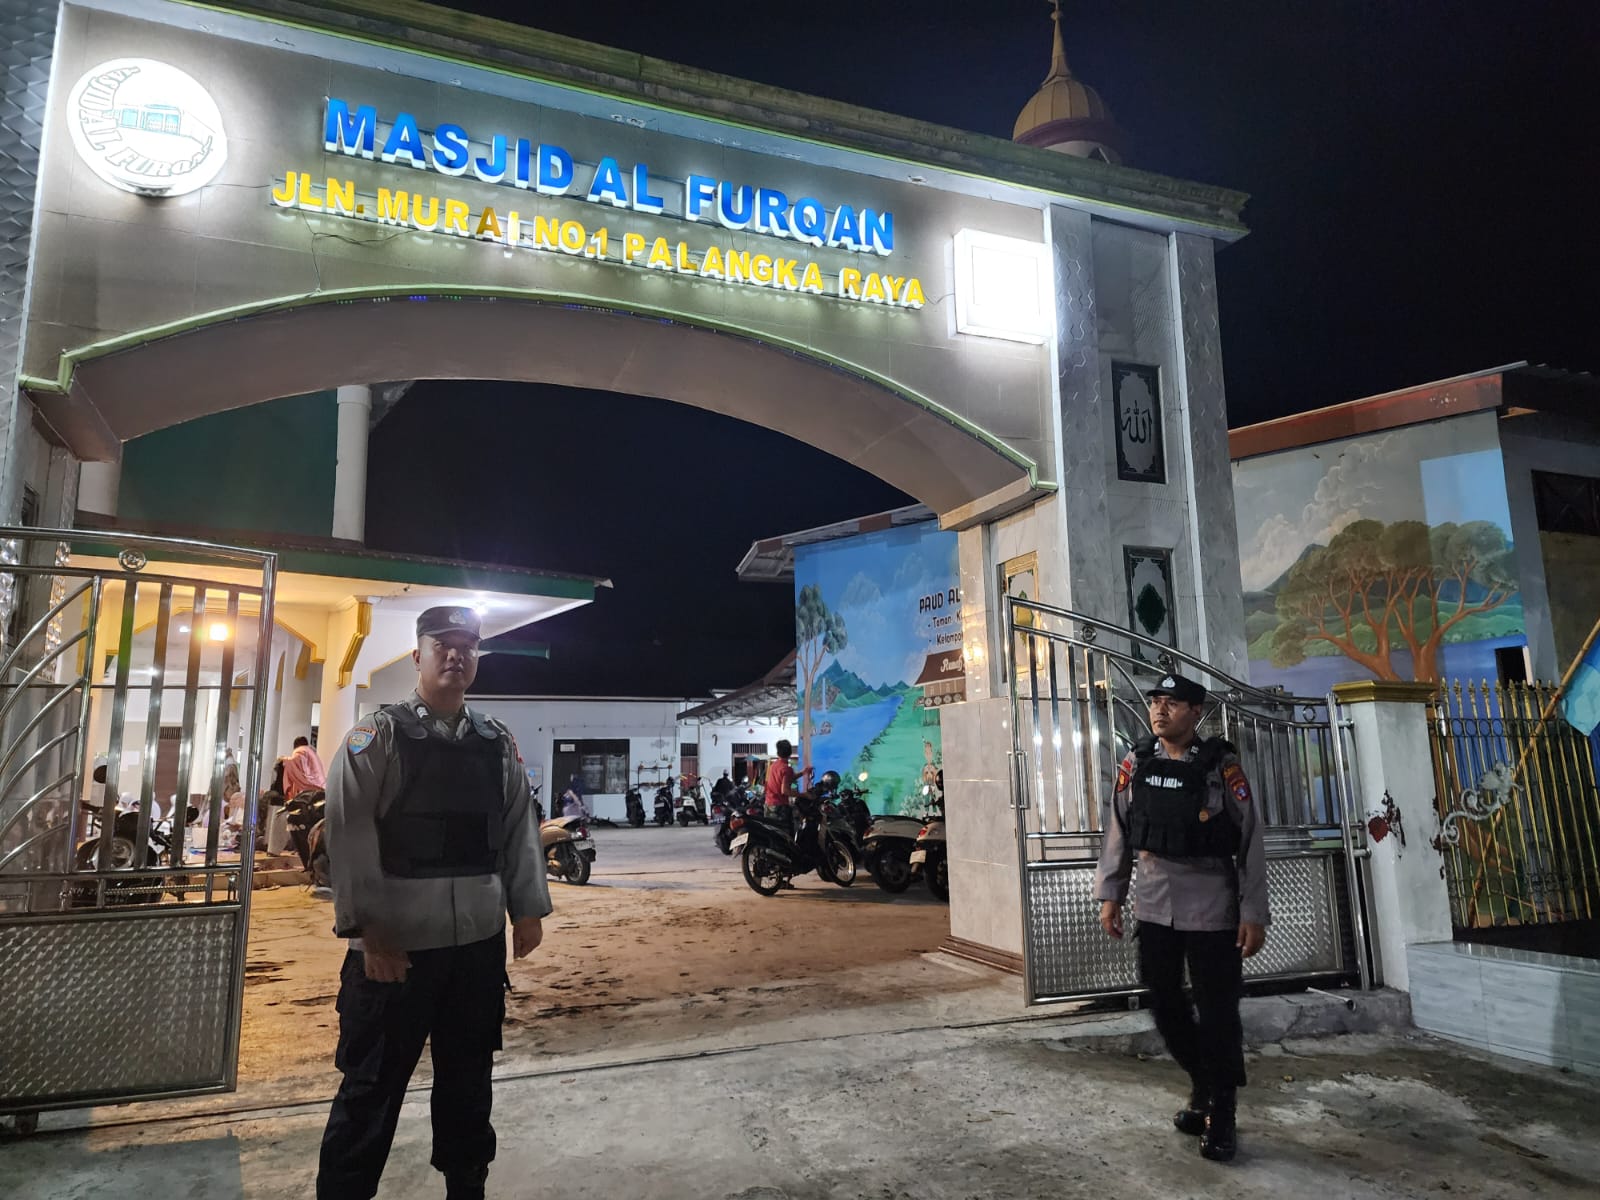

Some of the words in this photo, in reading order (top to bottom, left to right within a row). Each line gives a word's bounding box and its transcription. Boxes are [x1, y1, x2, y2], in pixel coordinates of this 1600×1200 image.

[272, 170, 364, 217] JLN.
[377, 187, 521, 246] MURAI
[532, 215, 608, 260] NO.1
[622, 231, 825, 294] PALANGKA
[838, 266, 926, 310] RAYA
[324, 97, 574, 196] MASJID
[587, 156, 664, 215] AL
[685, 174, 894, 257] FURQAN
[919, 592, 944, 614] PAUD
